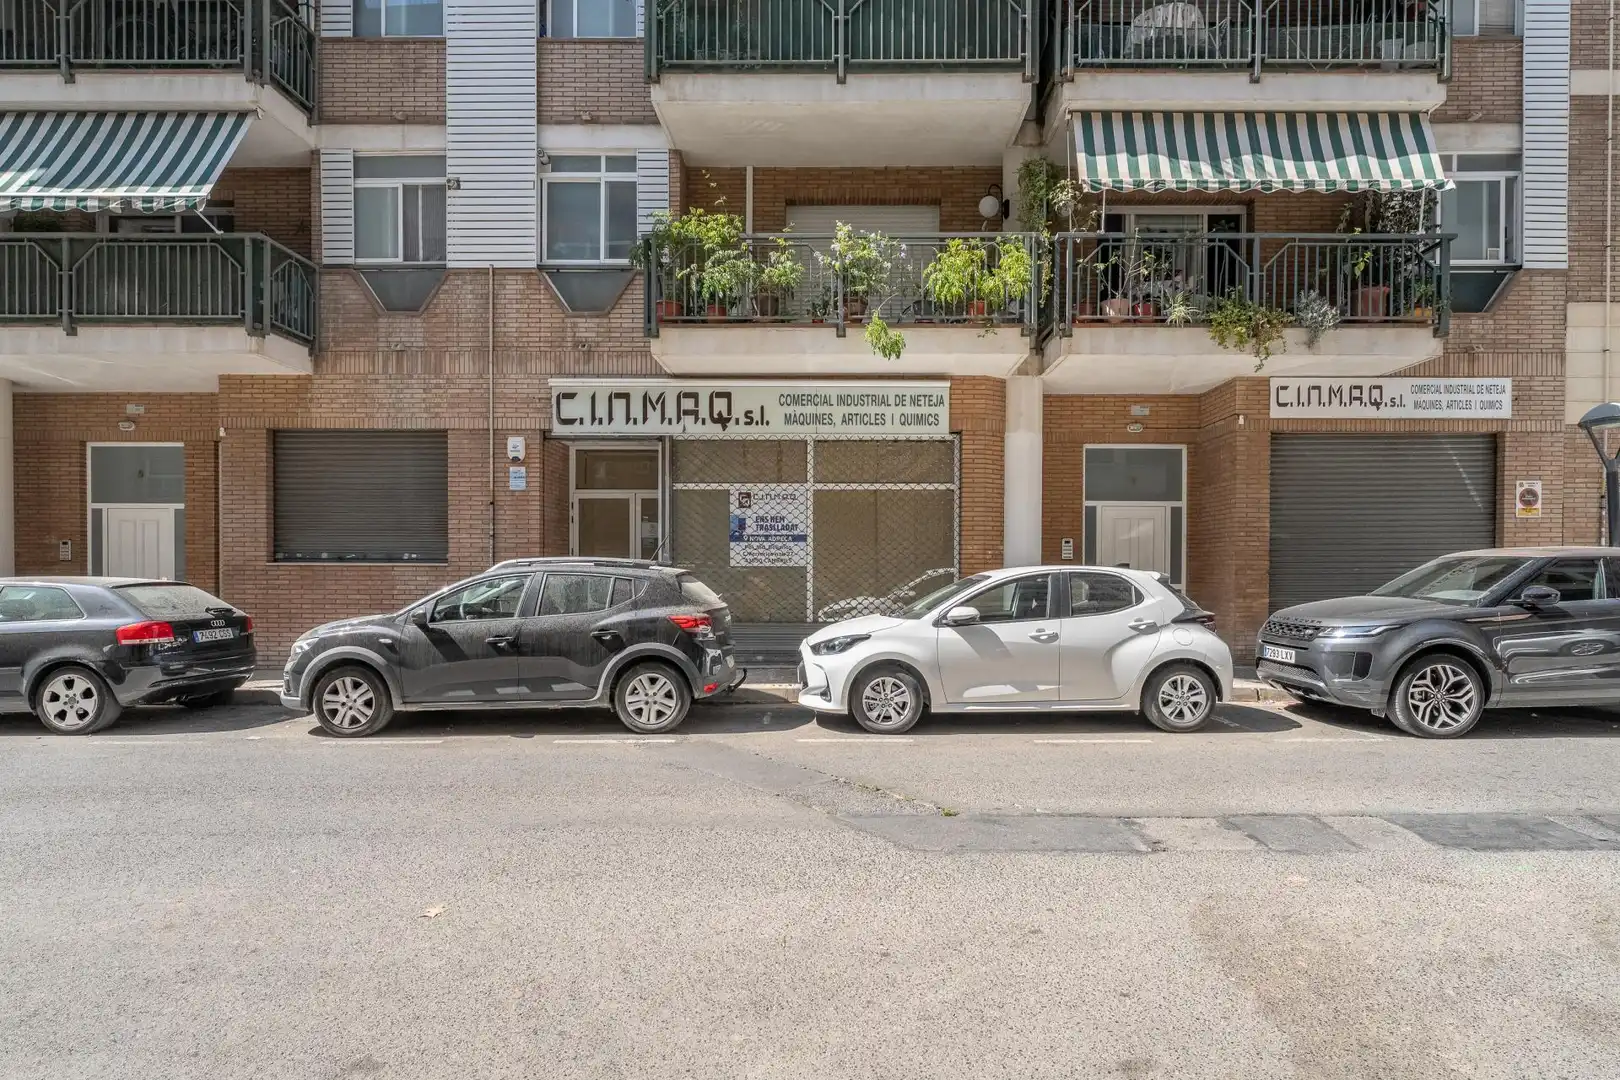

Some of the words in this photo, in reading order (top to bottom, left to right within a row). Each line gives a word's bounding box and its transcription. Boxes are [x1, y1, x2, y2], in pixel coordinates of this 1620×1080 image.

[1410, 384, 1442, 395] COMERCIAL
[1443, 384, 1476, 395] INDUSTRIAL
[1476, 384, 1484, 395] DE
[1485, 384, 1506, 395] NETEJA
[778, 393, 834, 407] COMERCIAL
[836, 393, 892, 407] INDUSTRIAL
[894, 393, 908, 407] DE
[909, 393, 945, 407] NETEJA
[1445, 399, 1473, 410] ARTICLES
[1479, 399, 1503, 410] QUIMICS
[784, 409, 836, 428] MÀQUINES,
[840, 412, 886, 427] ARTICLES
[899, 412, 940, 427] QUIMICS
[755, 515, 769, 523] ENS
[770, 515, 785, 523] HEM
[755, 523, 798, 532] TRASLLADAT
[200, 630, 218, 640] 7492
[1267, 647, 1280, 659] 7293
[1281, 649, 1294, 661] LXV
